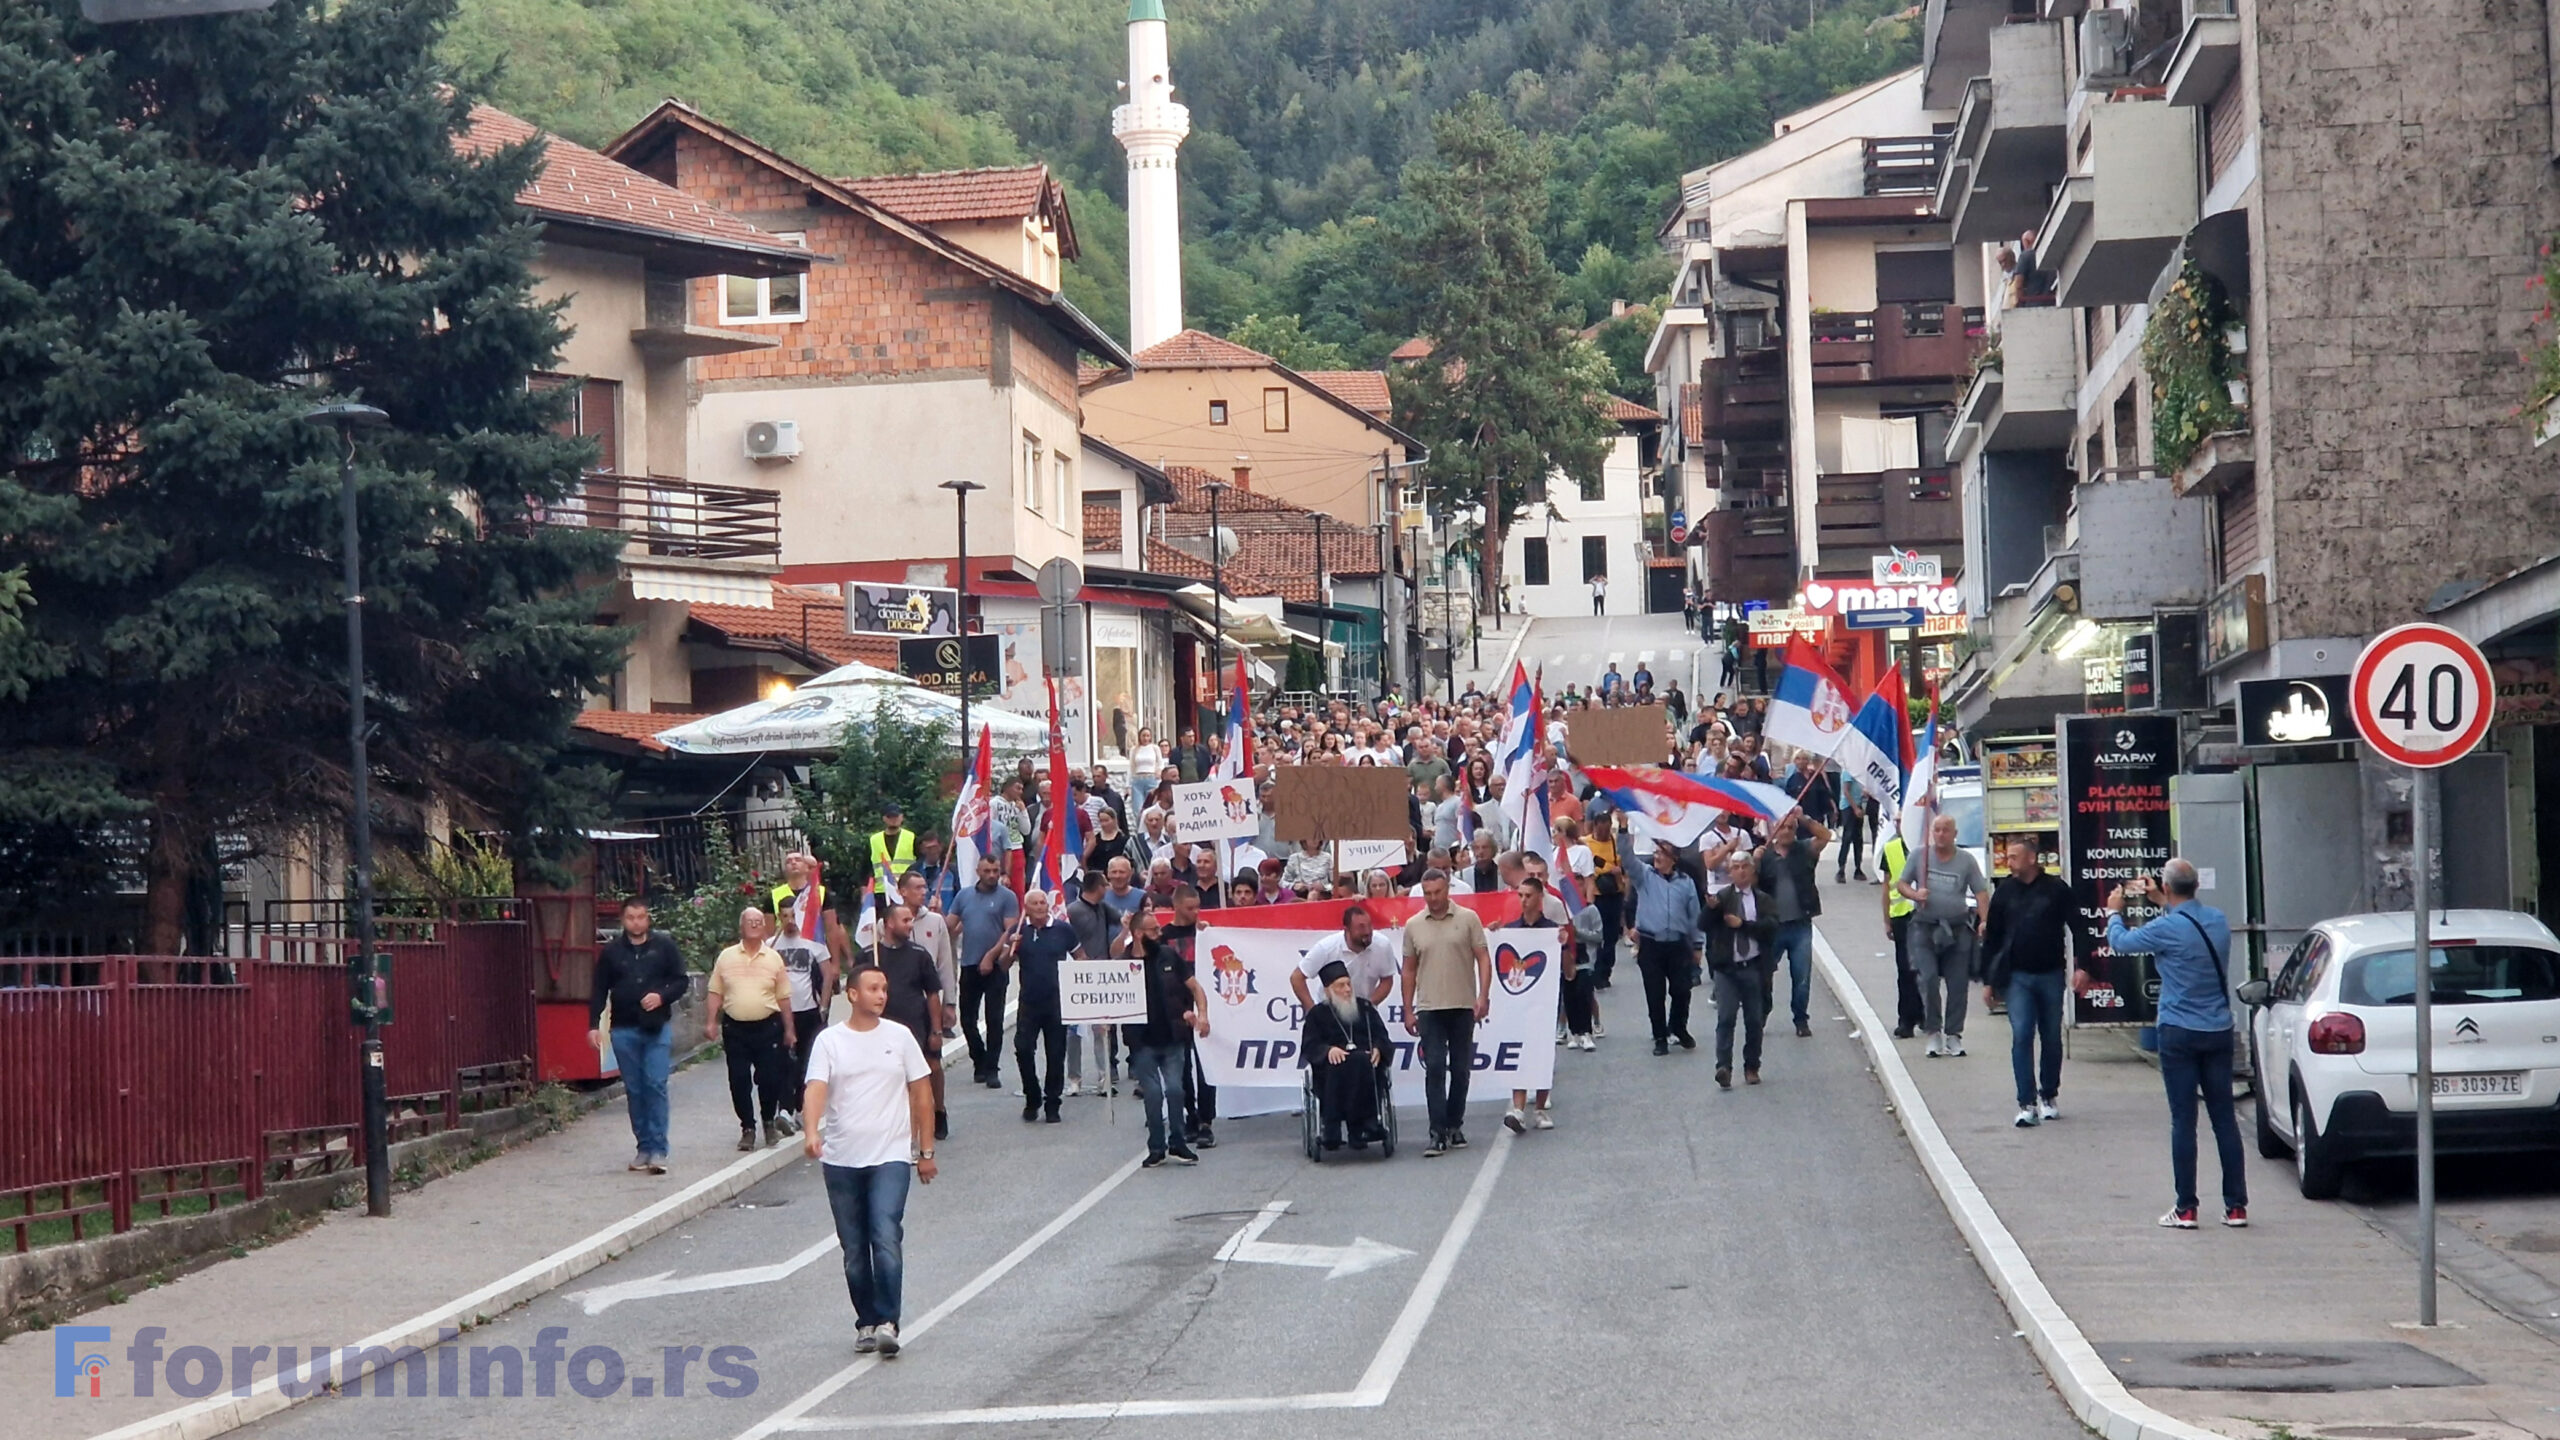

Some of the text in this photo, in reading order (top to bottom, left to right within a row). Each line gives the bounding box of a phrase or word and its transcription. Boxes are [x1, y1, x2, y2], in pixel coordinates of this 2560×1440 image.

[1880, 546, 1936, 575] volim
[1838, 584, 1959, 615] marke
[1921, 612, 1964, 633] mark
[1757, 629, 1816, 645] maret
[914, 670, 987, 686] KOD REKA
[2379, 663, 2463, 732] 40
[711, 736, 749, 746] Refreshing
[751, 733, 764, 745] soft
[765, 731, 784, 741] drink
[785, 730, 802, 740] with
[2094, 753, 2157, 764] ALTAPAY
[1867, 760, 1900, 804] ПРИЈЕ
[1183, 791, 1213, 802] ХОЋУ
[1192, 807, 1208, 816] ДА
[2078, 801, 2111, 813] SVIH
[1178, 820, 1218, 831] РАДИМ
[2107, 828, 2148, 839] TAKSE
[1348, 845, 1385, 857] УЧИМ!
[2087, 848, 2168, 860] KOMUNALIJE
[2082, 867, 2166, 880] SUDSKE TAKS
[2080, 906, 2168, 919] PLAT PROM
[1074, 972, 1130, 986] НЕ ДАМ
[1070, 992, 1136, 1005] СРБИЈУ!!!
[2431, 1075, 2519, 1094] BG 3039-ZE
